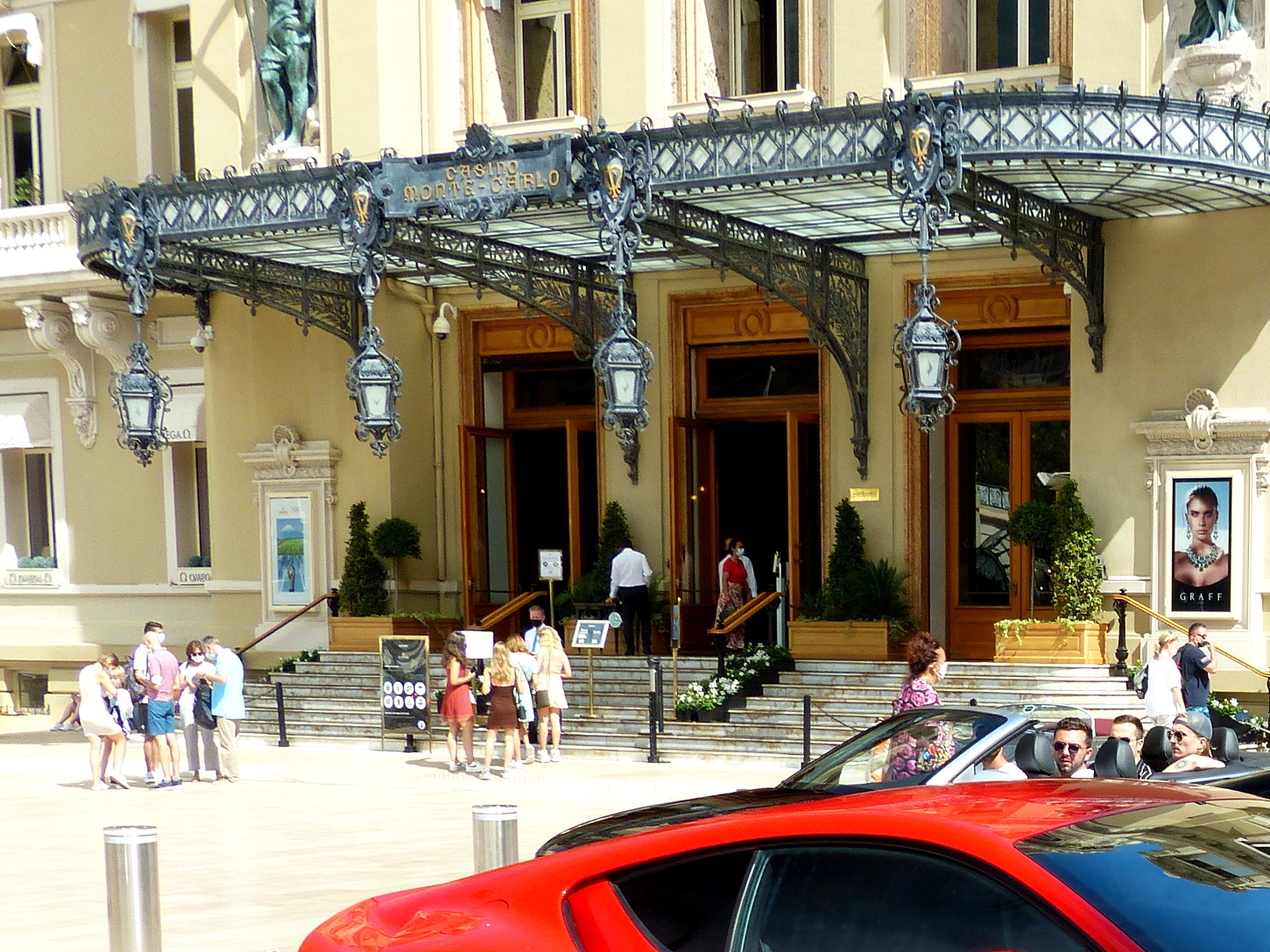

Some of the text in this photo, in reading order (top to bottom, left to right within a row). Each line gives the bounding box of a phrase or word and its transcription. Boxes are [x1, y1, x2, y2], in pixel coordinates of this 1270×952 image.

[445, 160, 519, 181] CASINO
[404, 170, 560, 202] MONTE-CARLO
[1179, 592, 1223, 601] GRAFF
